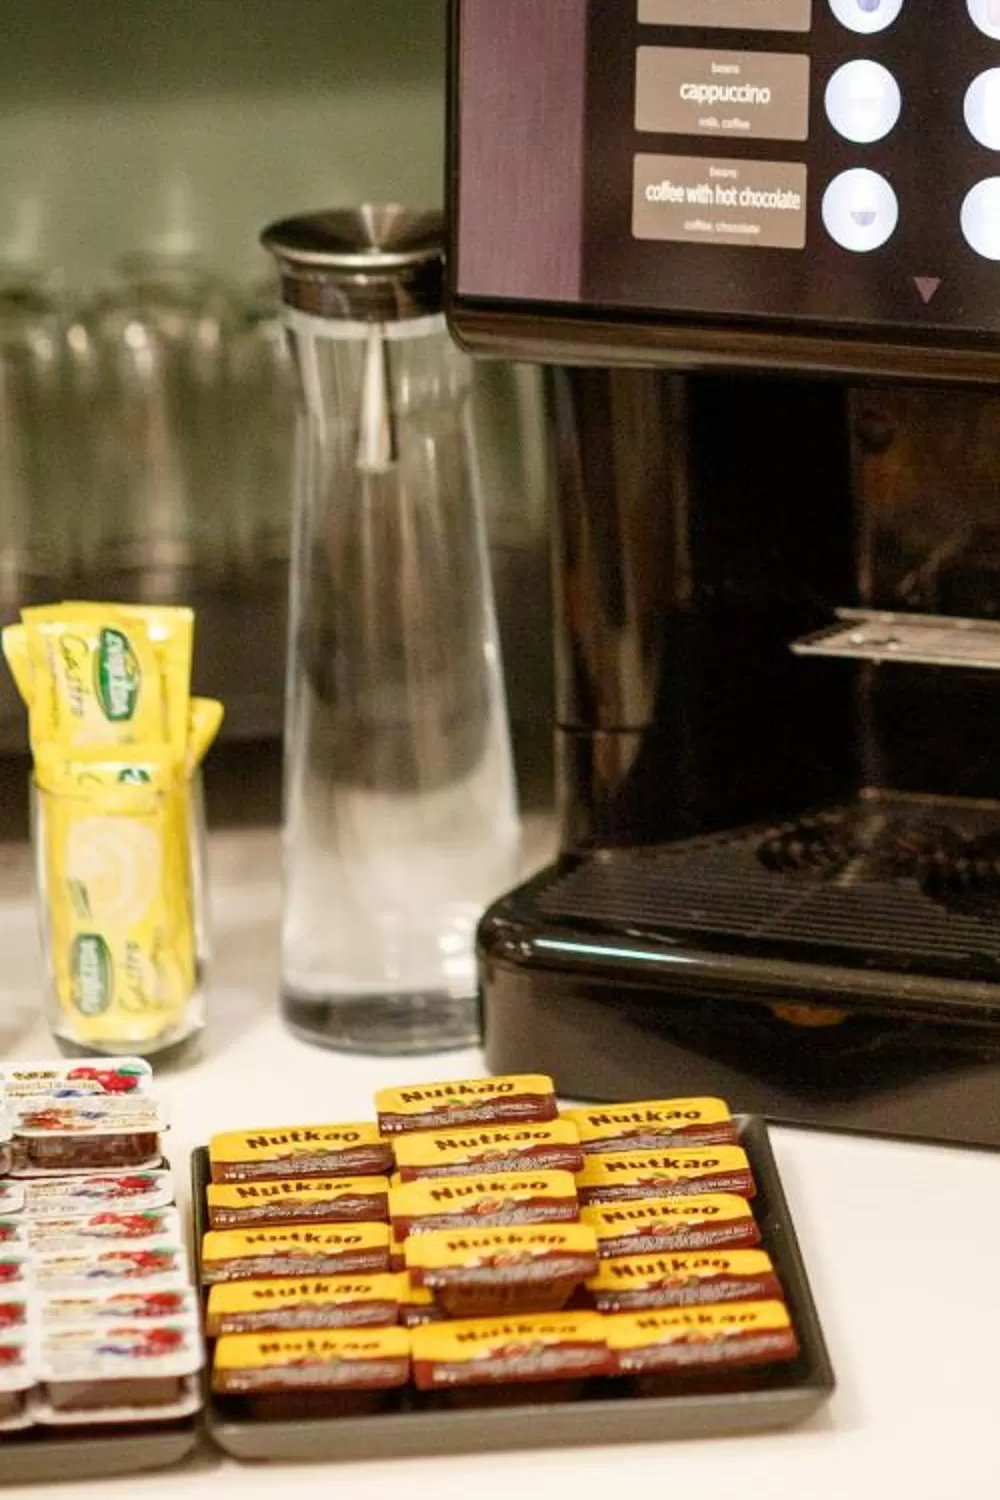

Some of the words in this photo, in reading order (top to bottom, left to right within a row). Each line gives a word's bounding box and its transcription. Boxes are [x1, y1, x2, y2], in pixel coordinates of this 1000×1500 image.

[680, 84, 771, 107] cappuccino
[645, 179, 685, 202] coffee
[686, 182, 713, 205] with
[715, 183, 738, 206] hot
[739, 185, 801, 210] chocolate
[401, 1082, 514, 1103] Nutkao
[588, 1109, 701, 1127] Nutkao
[246, 1131, 361, 1149] Nutkao
[434, 1131, 551, 1151] Nutkao
[604, 1156, 720, 1172] Nutkao
[430, 1180, 549, 1201] Nutkao
[601, 1205, 721, 1224] Nutkao
[610, 1257, 731, 1278] Nutkao
